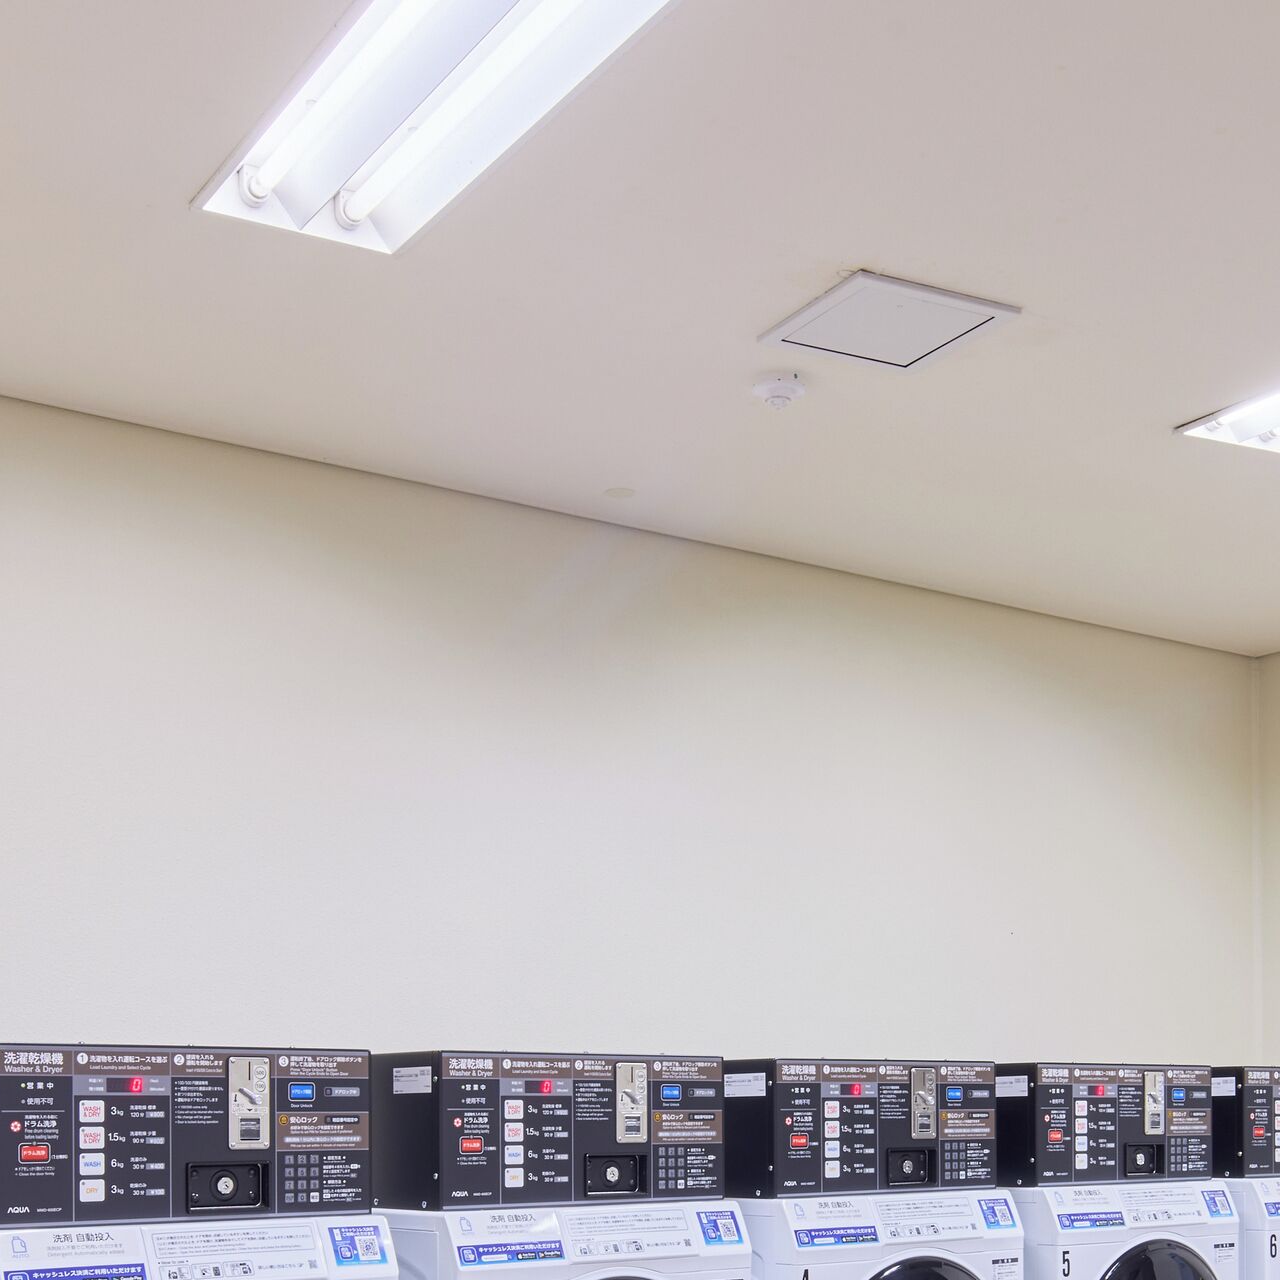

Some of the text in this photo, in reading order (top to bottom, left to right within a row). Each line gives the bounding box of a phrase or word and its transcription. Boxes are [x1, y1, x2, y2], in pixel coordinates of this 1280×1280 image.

[4, 1052, 64, 1065] 洗濯乾燥機
[4, 1065, 34, 1073] Washer
[43, 1066, 63, 1074] Dryer
[478, 1070, 493, 1078] Dryer
[133, 1079, 140, 1091] 0
[543, 1082, 550, 1093] 0
[27, 1098, 54, 1106] 使用不可
[25, 1120, 57, 1128] ドラム洗浄
[53, 1232, 114, 1243] 洗剤 自動投入
[1270, 1234, 1277, 1258] 6
[1062, 1251, 1070, 1277] 5
